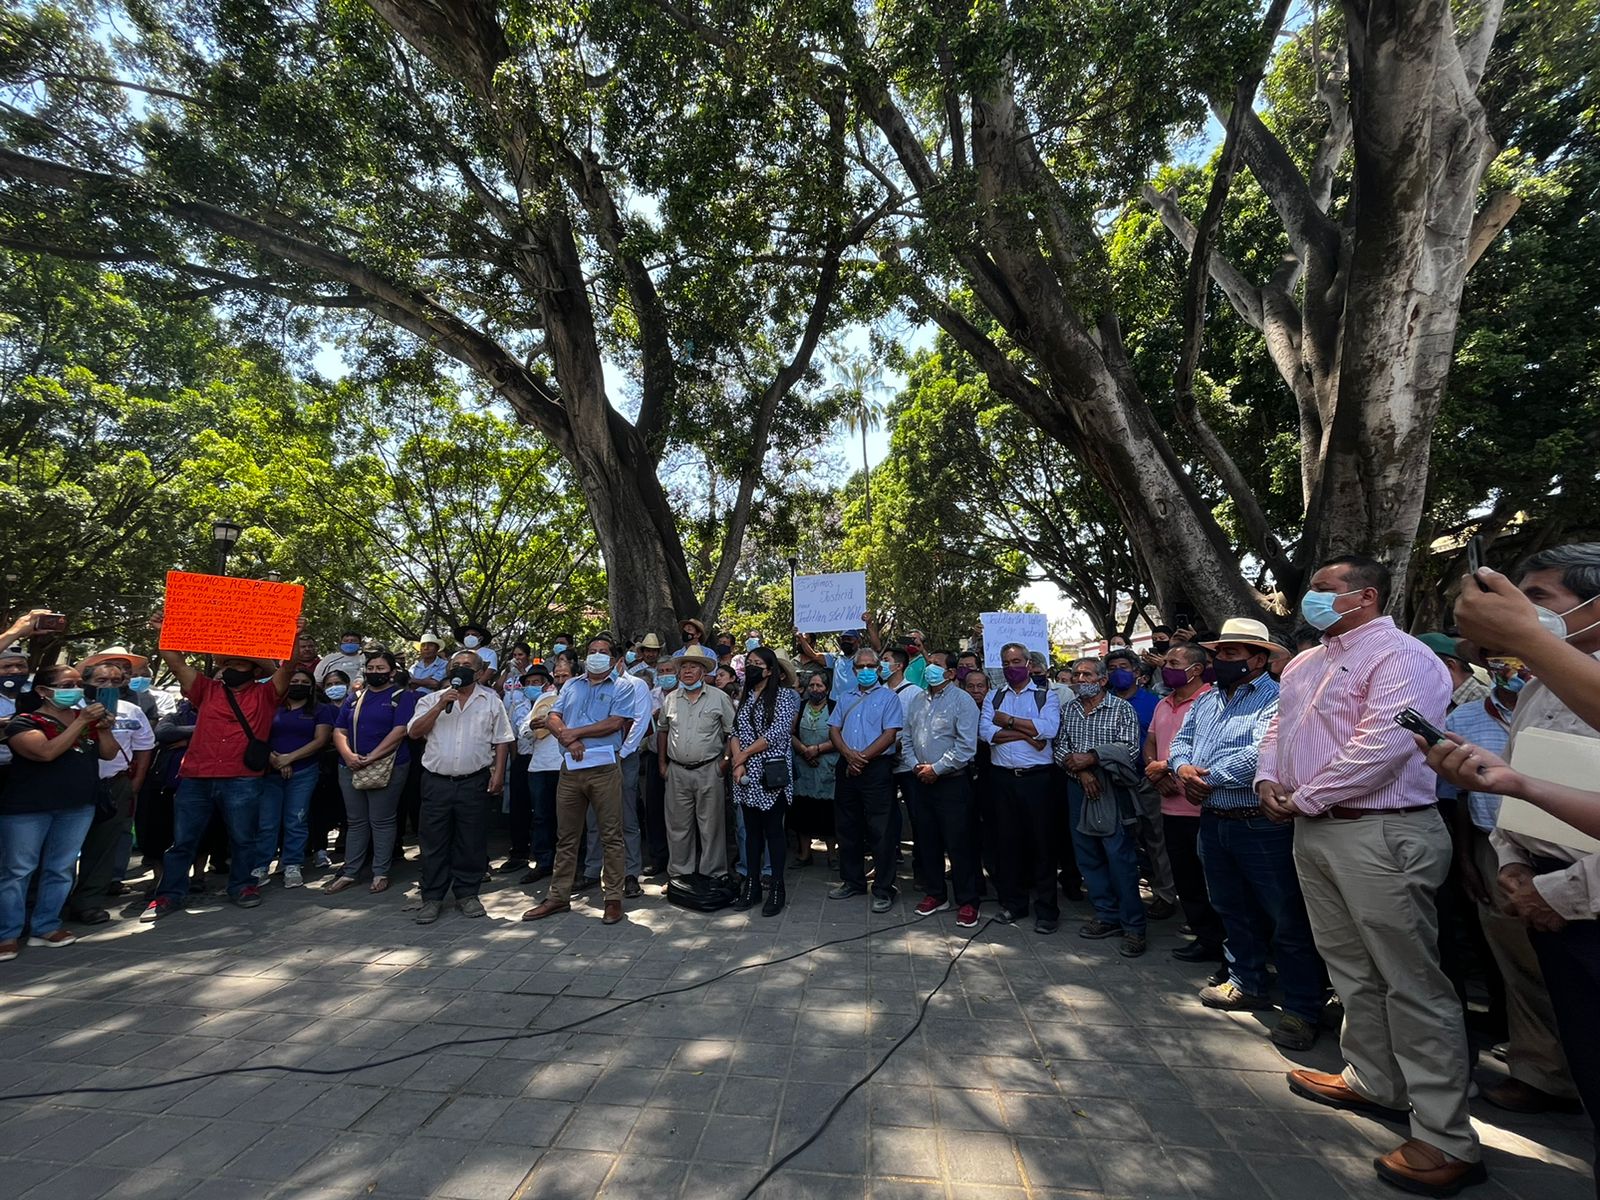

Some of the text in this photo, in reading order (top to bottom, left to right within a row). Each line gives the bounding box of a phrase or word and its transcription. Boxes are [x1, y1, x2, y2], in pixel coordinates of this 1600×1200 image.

[168, 583, 209, 592] NUESTRA
[229, 578, 283, 594] RESPETO
[287, 587, 297, 595] A
